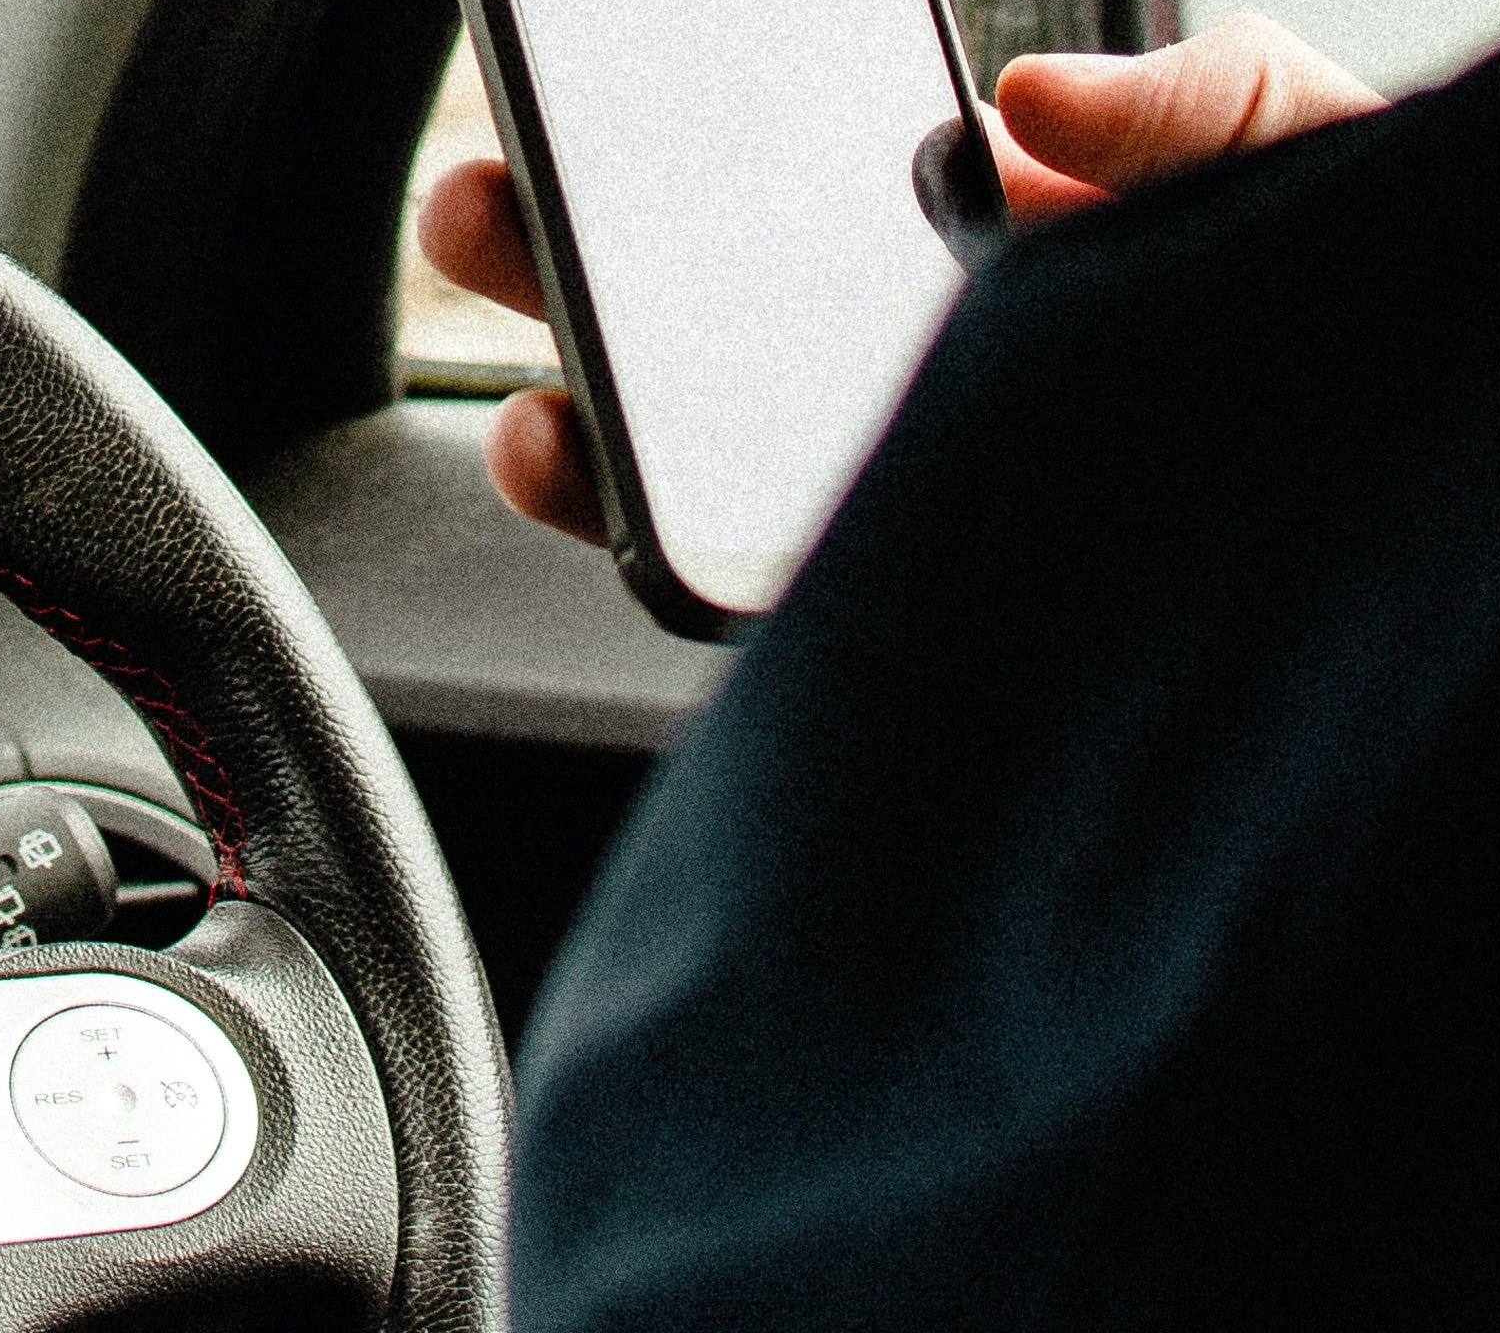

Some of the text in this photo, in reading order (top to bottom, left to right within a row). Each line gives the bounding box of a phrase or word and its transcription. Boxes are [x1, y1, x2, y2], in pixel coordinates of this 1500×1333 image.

[79, 1027, 123, 1043] SET
[34, 1090, 84, 1106] RES
[109, 1153, 153, 1170] SET
